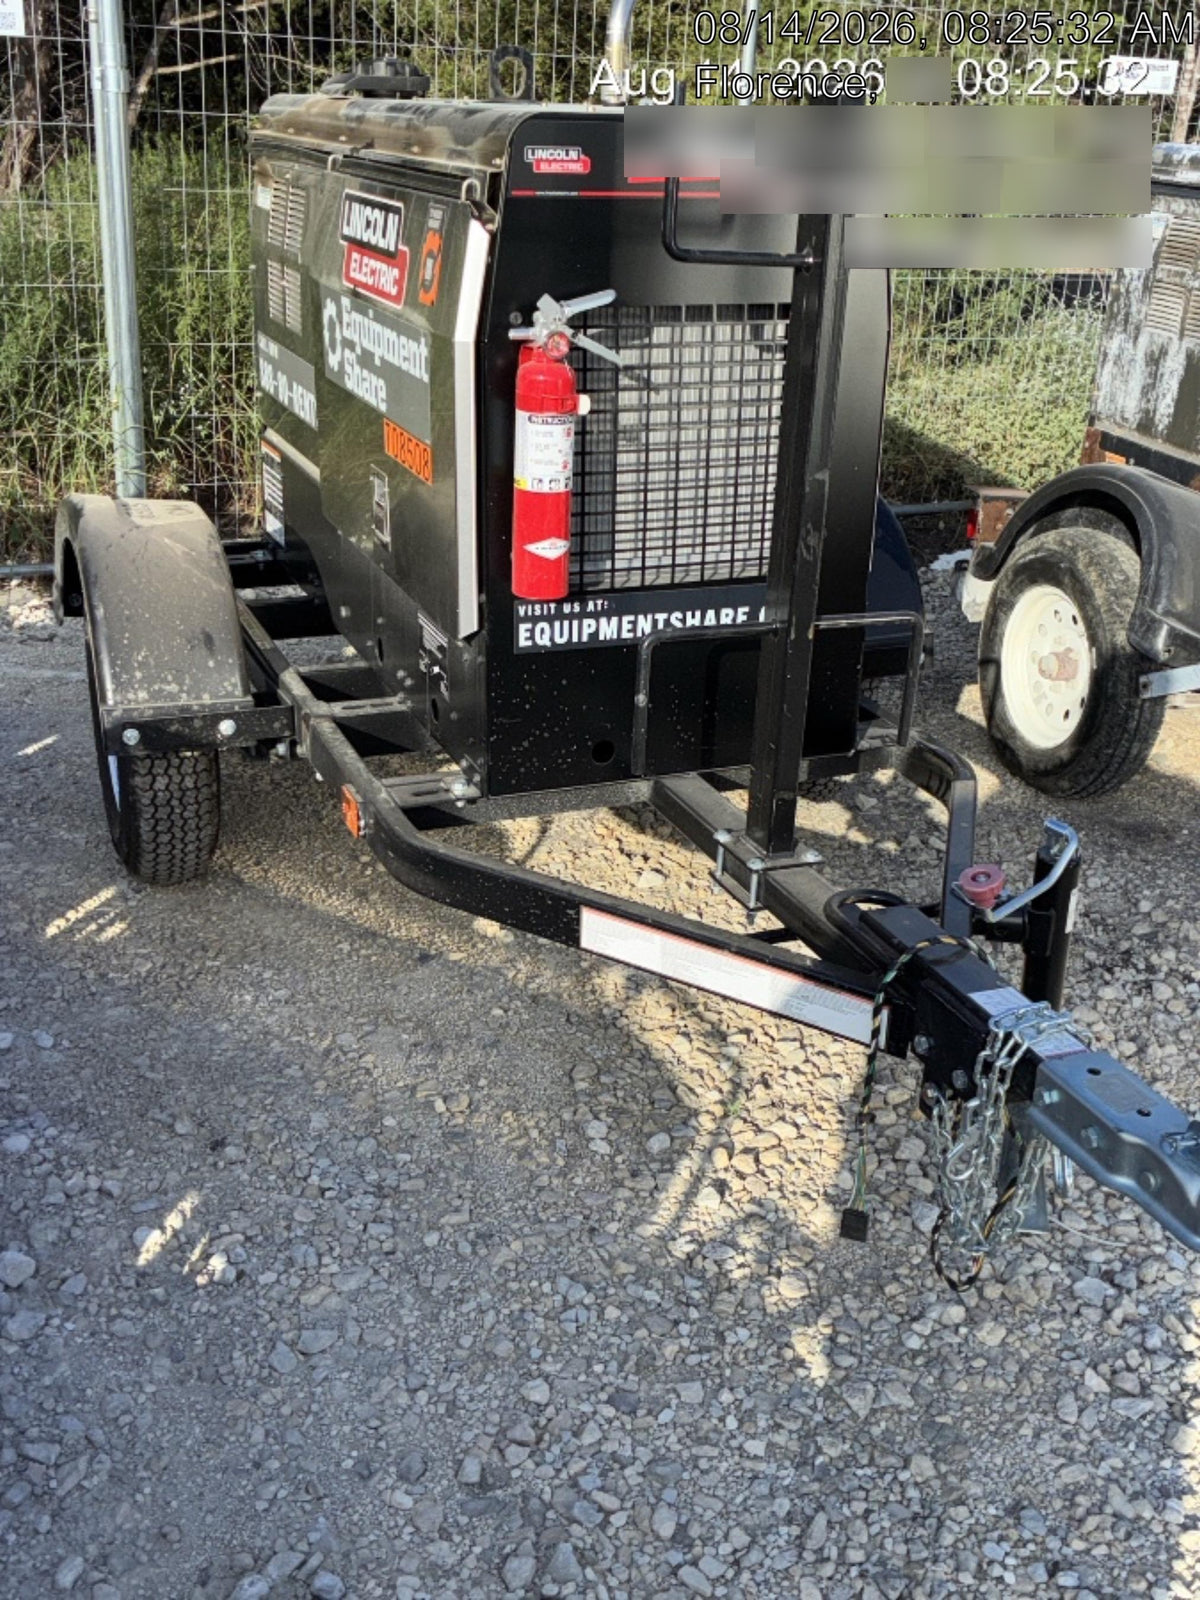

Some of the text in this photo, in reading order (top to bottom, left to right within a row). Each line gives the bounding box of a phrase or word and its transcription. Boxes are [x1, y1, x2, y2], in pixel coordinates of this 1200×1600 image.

[527, 148, 579, 161] LINCOLN
[540, 161, 584, 172] ELECTRIC
[343, 200, 399, 252] LINCOLN
[350, 252, 399, 295] ELECTRIC
[341, 296, 430, 383] Equipment
[344, 348, 387, 413] Share
[518, 600, 609, 617] VISIT US AT:
[518, 605, 766, 648] EQUIPMENTSHARE
